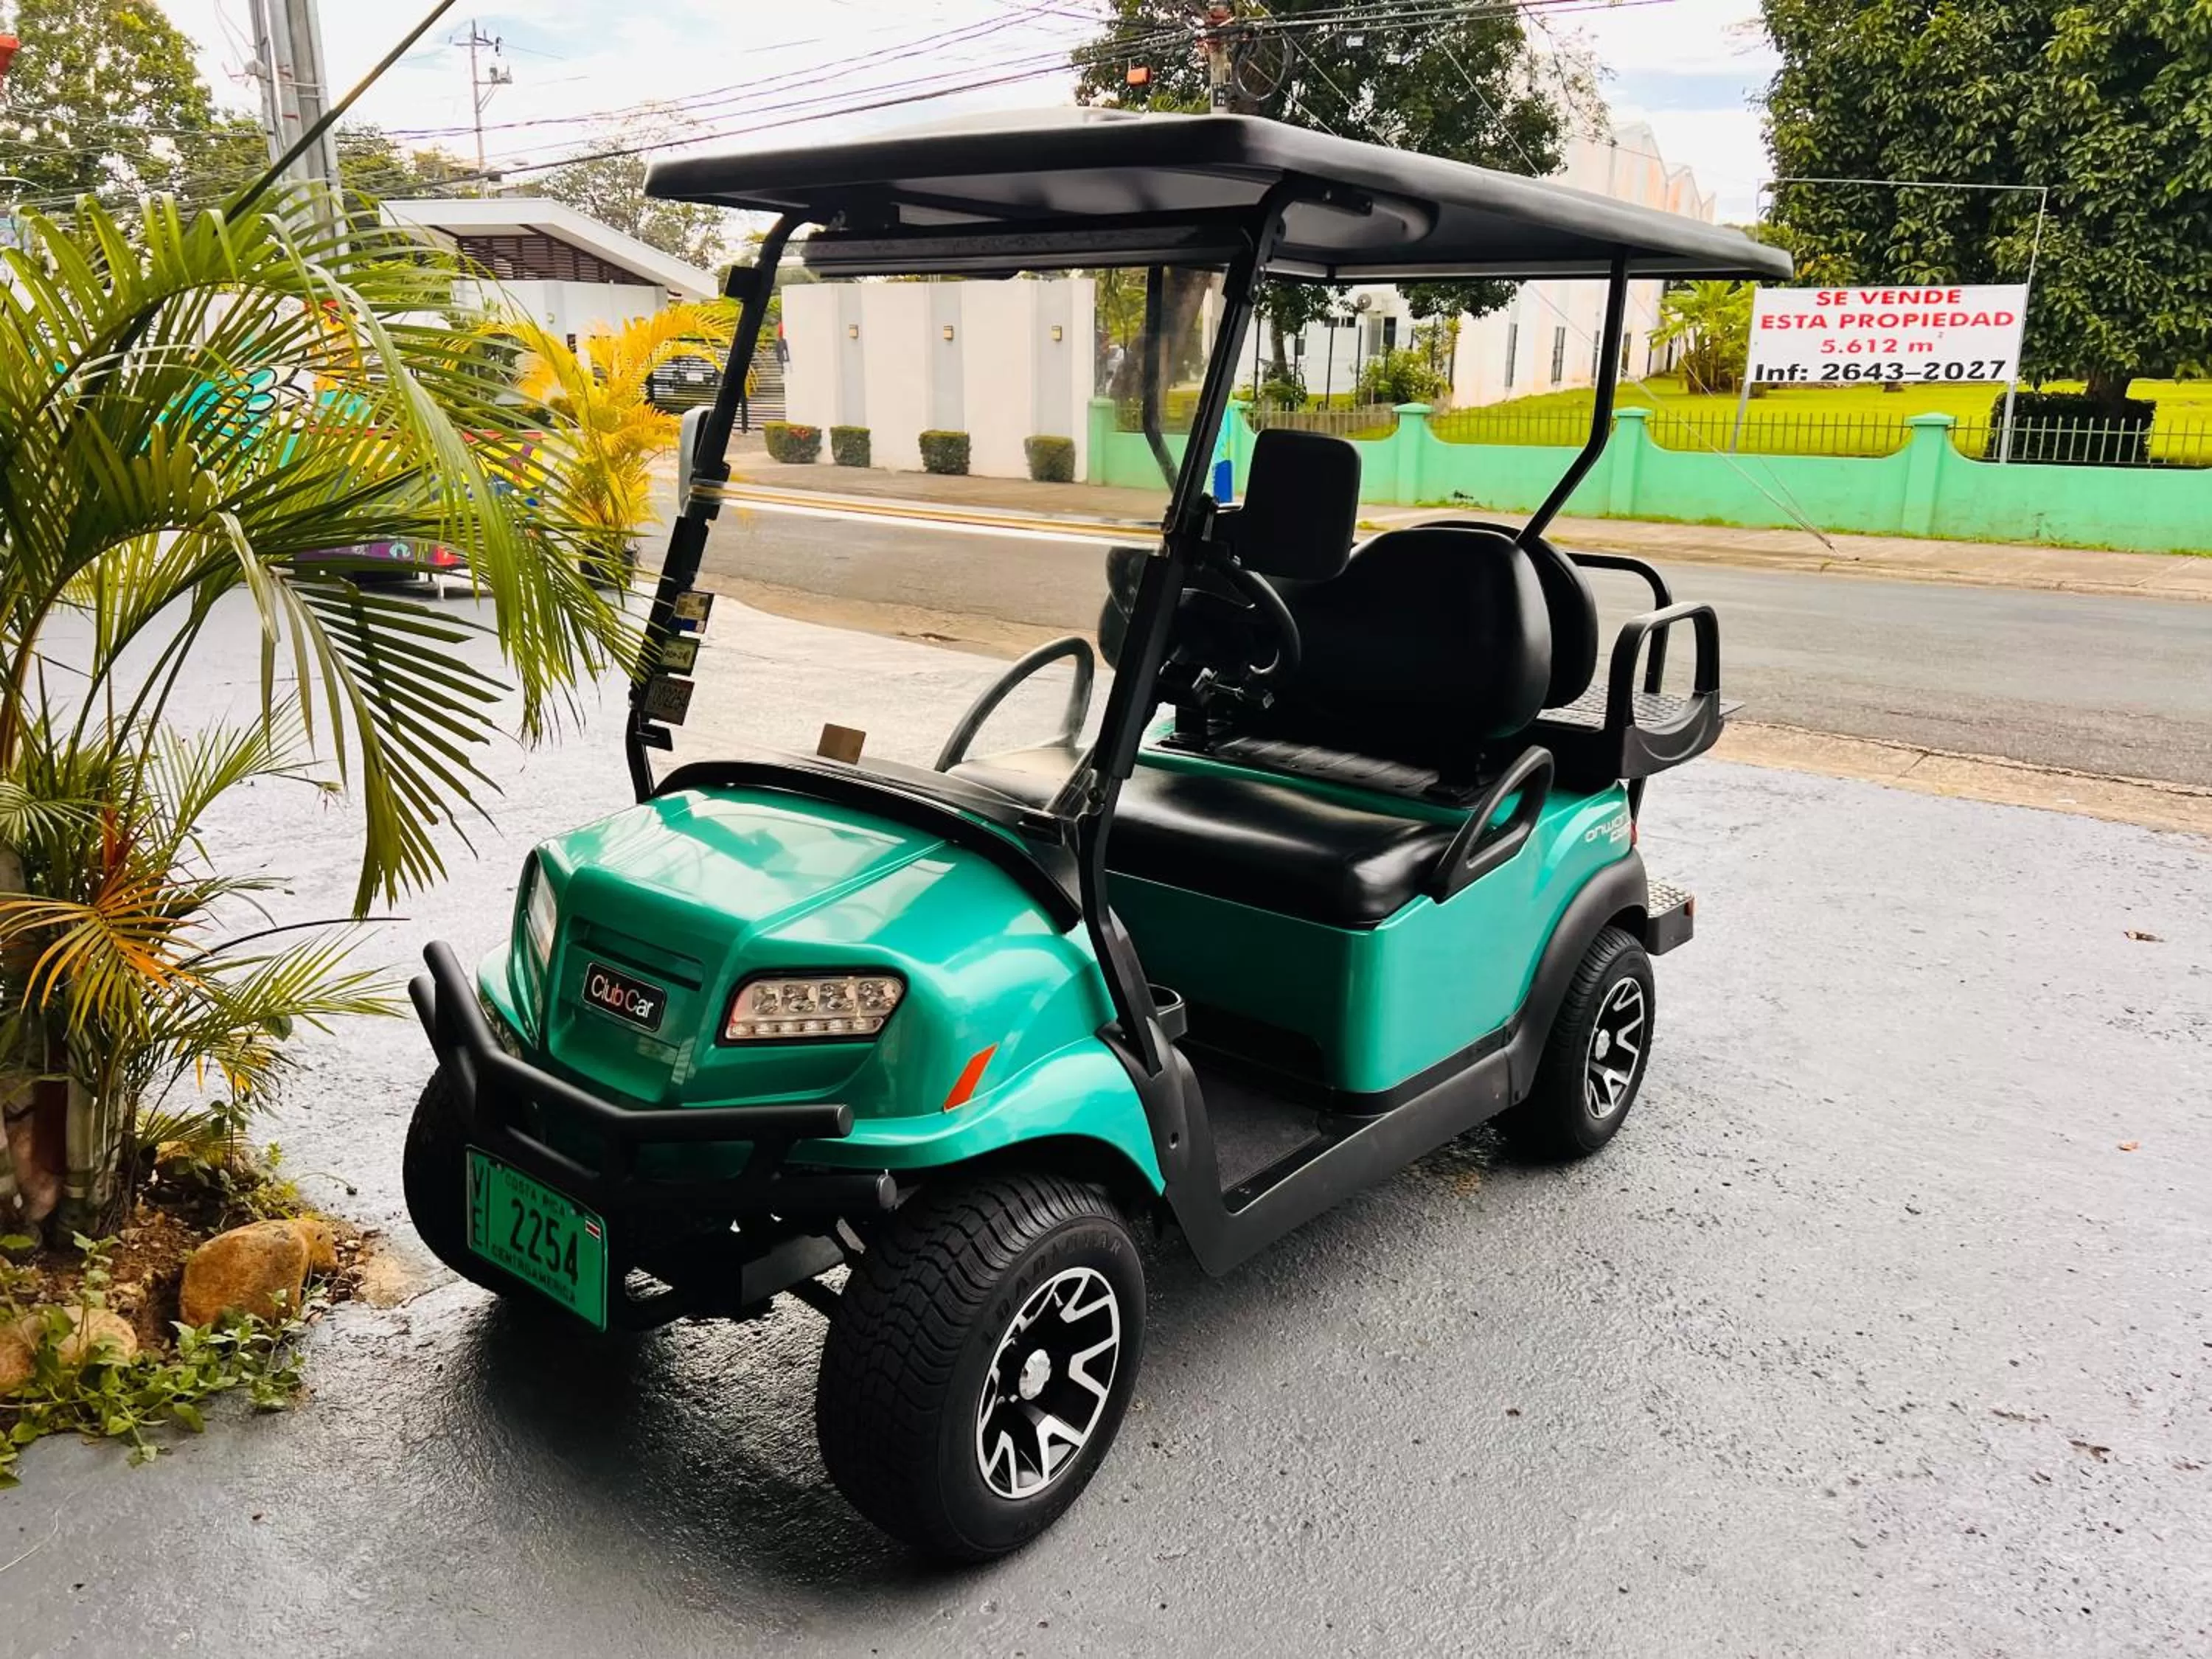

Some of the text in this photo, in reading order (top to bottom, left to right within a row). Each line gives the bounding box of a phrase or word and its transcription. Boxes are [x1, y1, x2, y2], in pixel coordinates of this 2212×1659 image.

[1816, 288, 1962, 306] SE VENDE
[1760, 311, 2015, 330] ESTA PROPIEDAD
[1820, 338, 1898, 354] 5.612
[1755, 360, 2006, 381] Inf: 2643-2027
[591, 974, 655, 1018] Club Car
[509, 1197, 579, 1287] 2254
